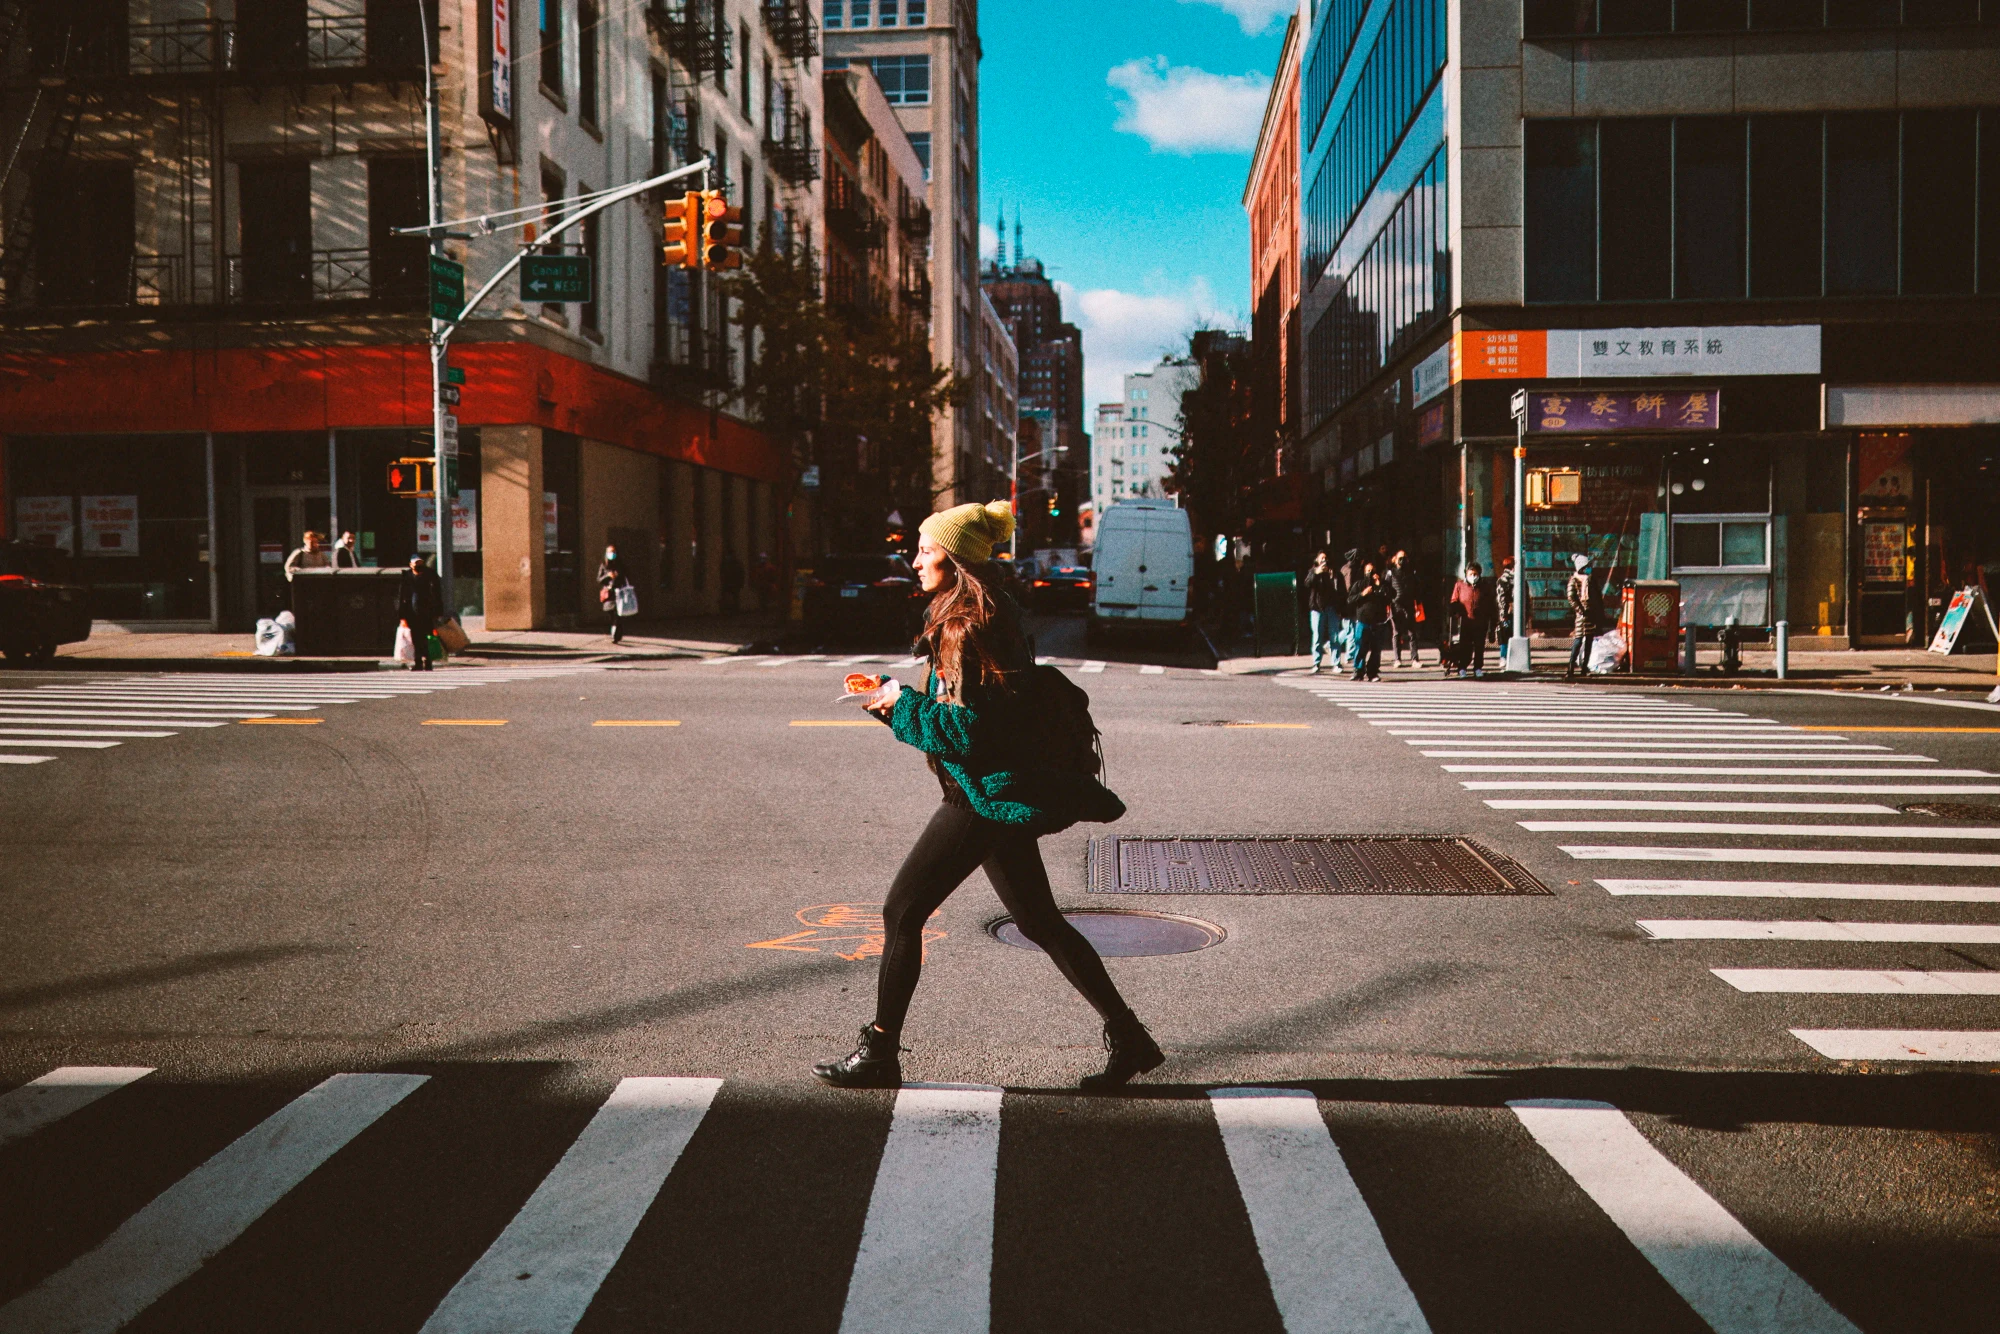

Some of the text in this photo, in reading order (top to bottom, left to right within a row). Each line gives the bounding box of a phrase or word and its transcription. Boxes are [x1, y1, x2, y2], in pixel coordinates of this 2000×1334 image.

[532, 264, 578, 277] Canal St
[553, 280, 582, 292] WEST
[1592, 338, 1724, 356] 雙文教育系統
